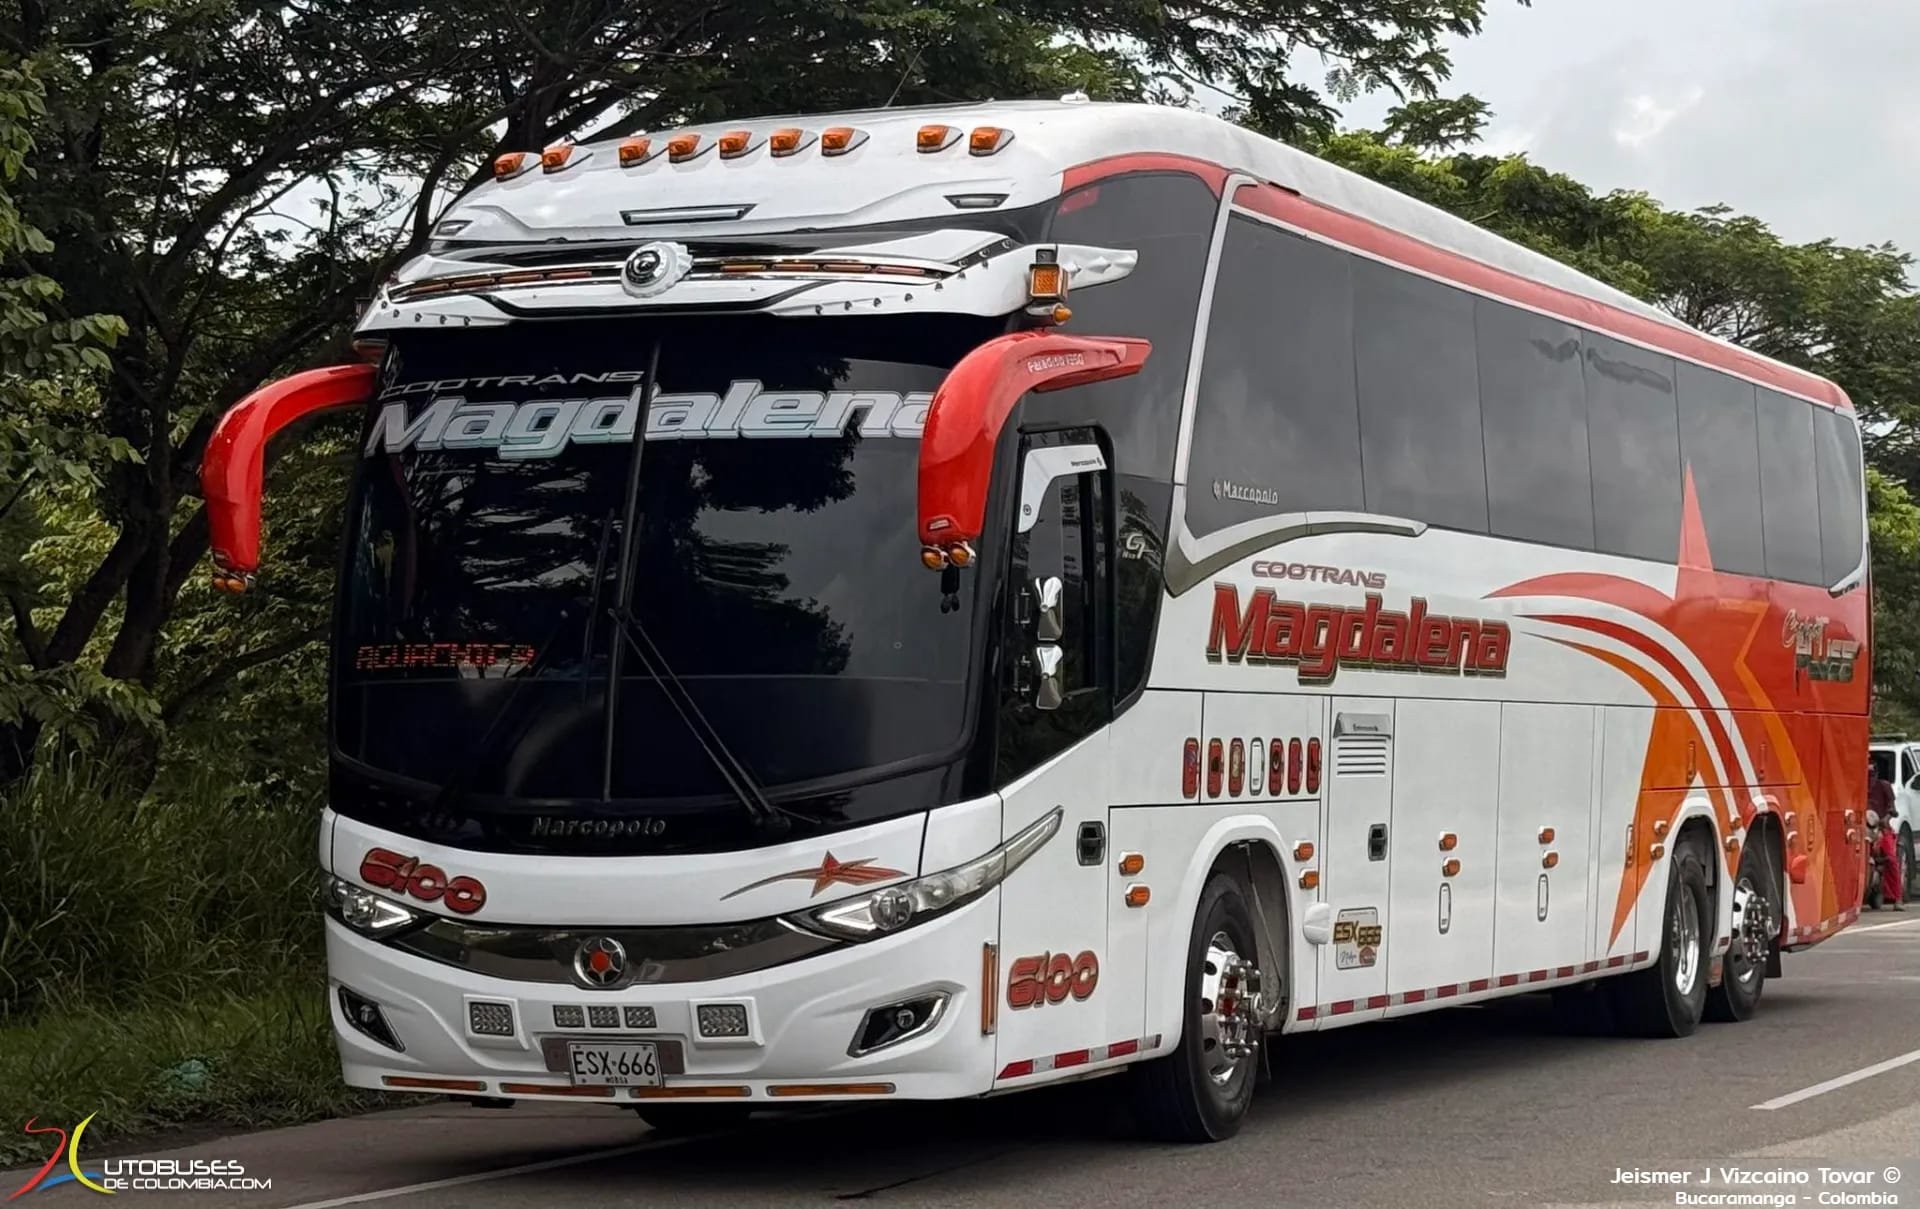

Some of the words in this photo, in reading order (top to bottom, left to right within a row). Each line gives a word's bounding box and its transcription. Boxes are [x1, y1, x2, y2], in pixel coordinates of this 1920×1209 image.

[379, 371, 645, 399] COOTRANS
[1223, 480, 1278, 505] Marcopolo
[1251, 560, 1387, 588] COOTRANS
[1206, 581, 1511, 687] Magdalena
[531, 817, 667, 837] Marcopolo
